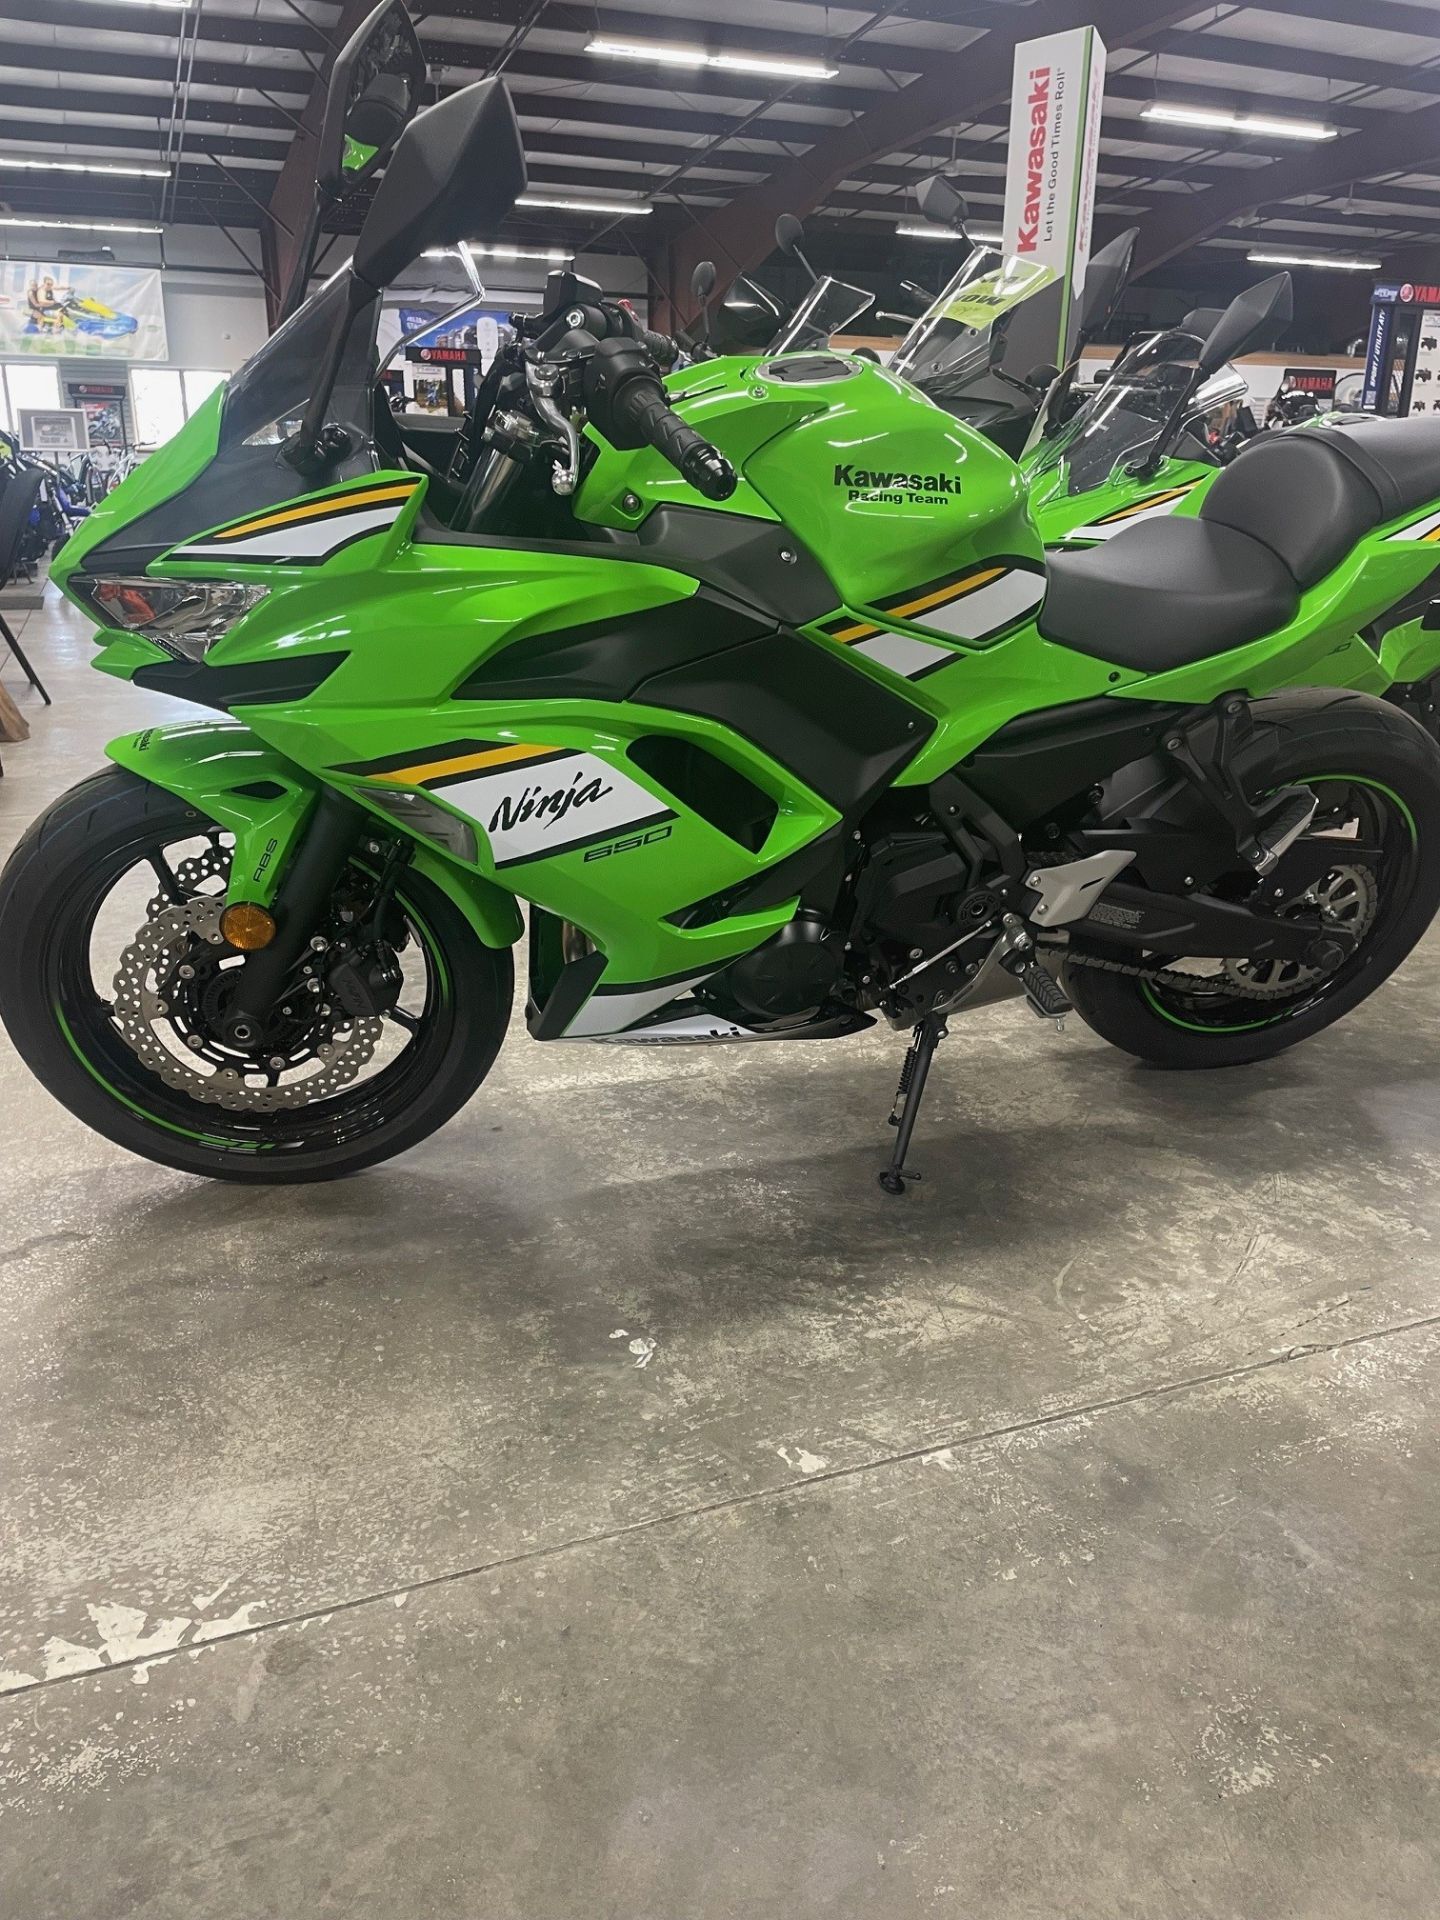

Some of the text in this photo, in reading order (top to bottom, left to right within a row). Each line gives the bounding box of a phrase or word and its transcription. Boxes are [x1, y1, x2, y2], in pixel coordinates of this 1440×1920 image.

[1051, 104, 1063, 148] Times
[1017, 67, 1051, 253] Kawasaki
[1048, 151, 1059, 189] Good
[1046, 193, 1056, 215] the
[1043, 220, 1054, 242] Let
[431, 350, 467, 361] YAMAHA
[1374, 324, 1385, 356] UTILITY
[1296, 377, 1333, 391] YAMAHA
[1370, 361, 1379, 388] SPORT
[834, 464, 962, 495] Kawasaki
[848, 489, 949, 505] Racing Team
[488, 771, 613, 833] Ninja
[583, 825, 672, 863] 650
[253, 838, 278, 883] ABS
